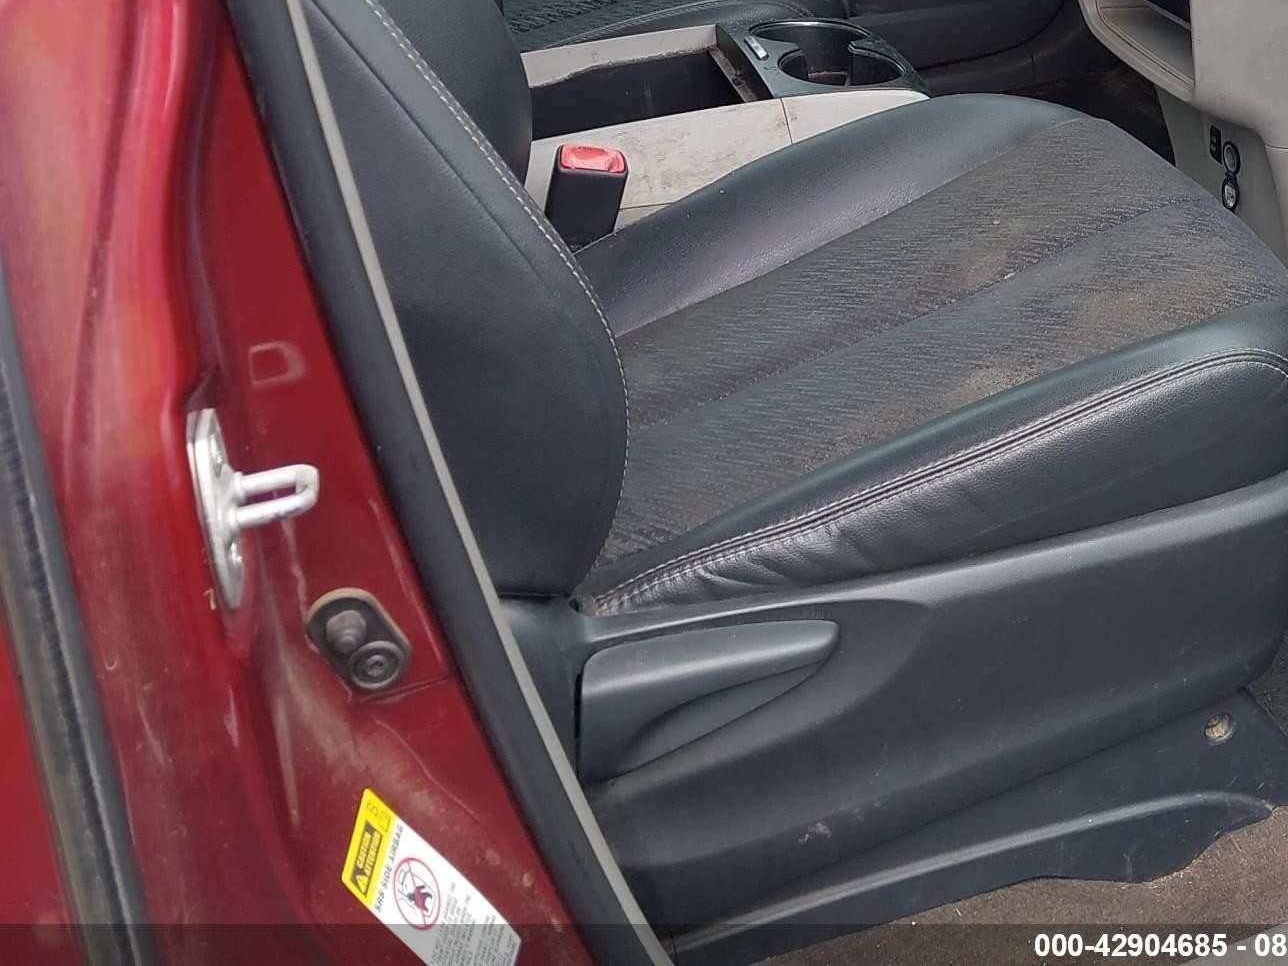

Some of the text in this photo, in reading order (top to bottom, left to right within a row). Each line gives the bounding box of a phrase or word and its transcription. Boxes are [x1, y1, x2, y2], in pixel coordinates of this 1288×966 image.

[356, 833, 372, 868] CAUTION
[363, 830, 382, 876] ATTENTION
[374, 825, 404, 912] SRS SIDE AIRBAG
